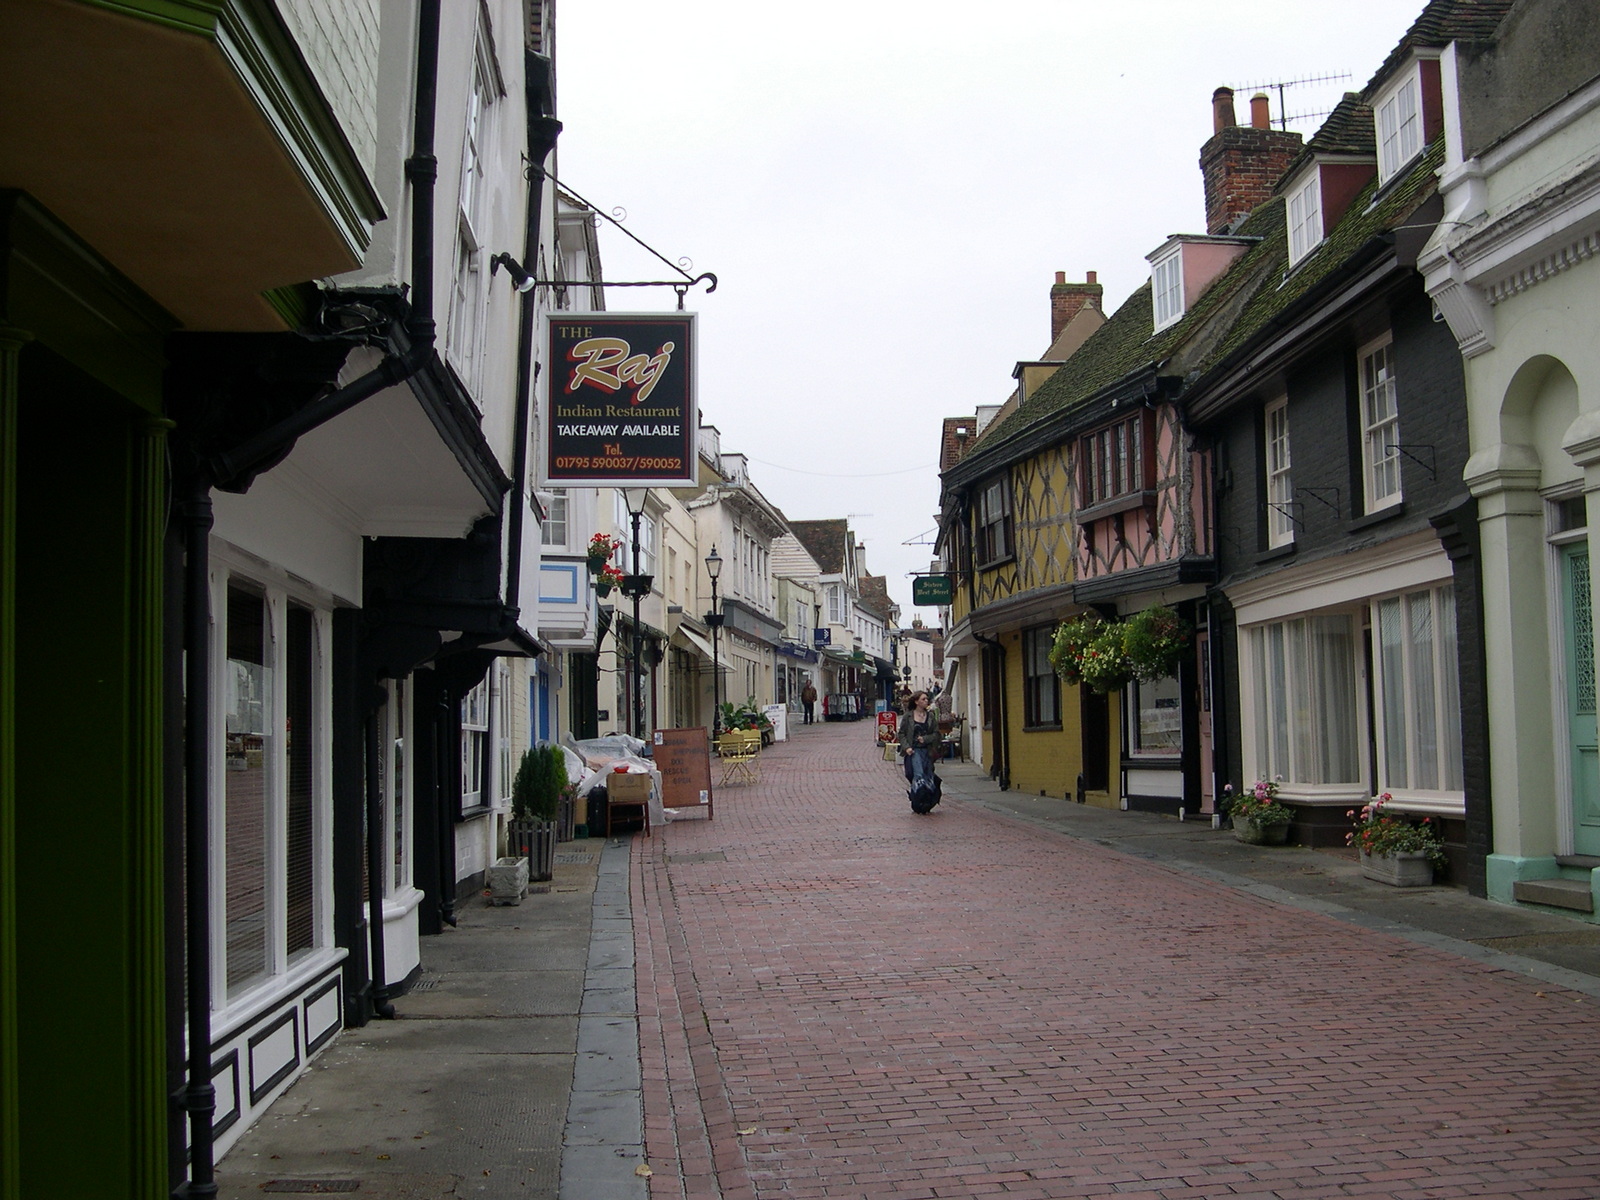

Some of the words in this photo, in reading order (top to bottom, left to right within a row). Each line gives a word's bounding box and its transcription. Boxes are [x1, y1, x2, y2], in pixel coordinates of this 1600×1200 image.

[559, 326, 593, 338] THE
[564, 337, 675, 405] Raj
[557, 405, 602, 418] Indian
[606, 405, 681, 417] Restaurant
[557, 425, 619, 436] TAKEAWAY
[622, 425, 680, 436] AVAILABLE
[605, 444, 623, 455] Tel.
[556, 457, 590, 469] 01795
[592, 457, 681, 470] 590037/590052
